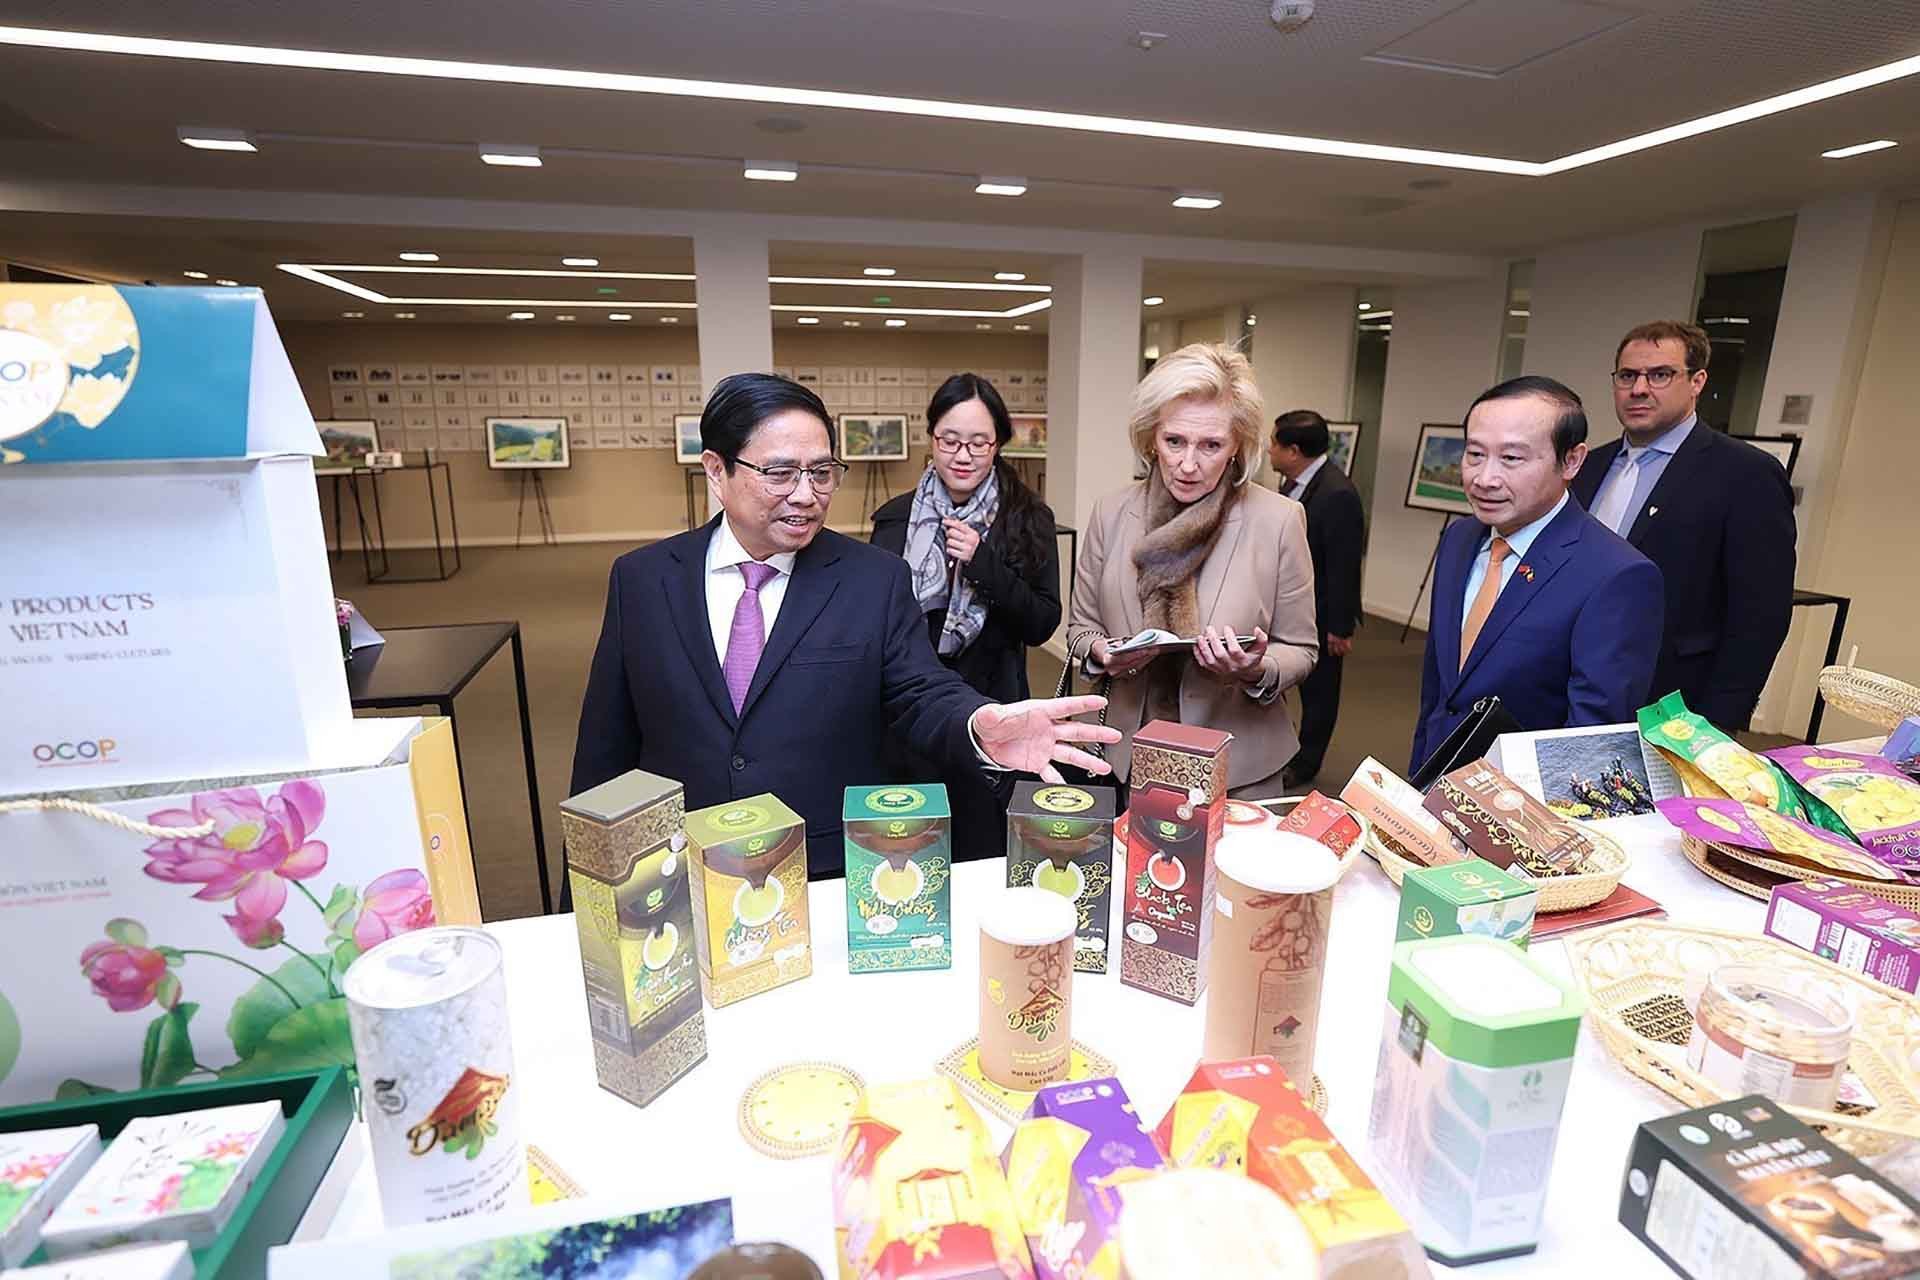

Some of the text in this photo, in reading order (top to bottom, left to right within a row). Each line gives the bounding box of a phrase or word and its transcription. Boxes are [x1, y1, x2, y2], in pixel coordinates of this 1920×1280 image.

[11, 592, 155, 616] PRODUCTS
[9, 619, 129, 643] VIETNAM
[32, 738, 116, 762] OCOP
[1174, 893, 1193, 914] Tea
[773, 911, 800, 936] Tea
